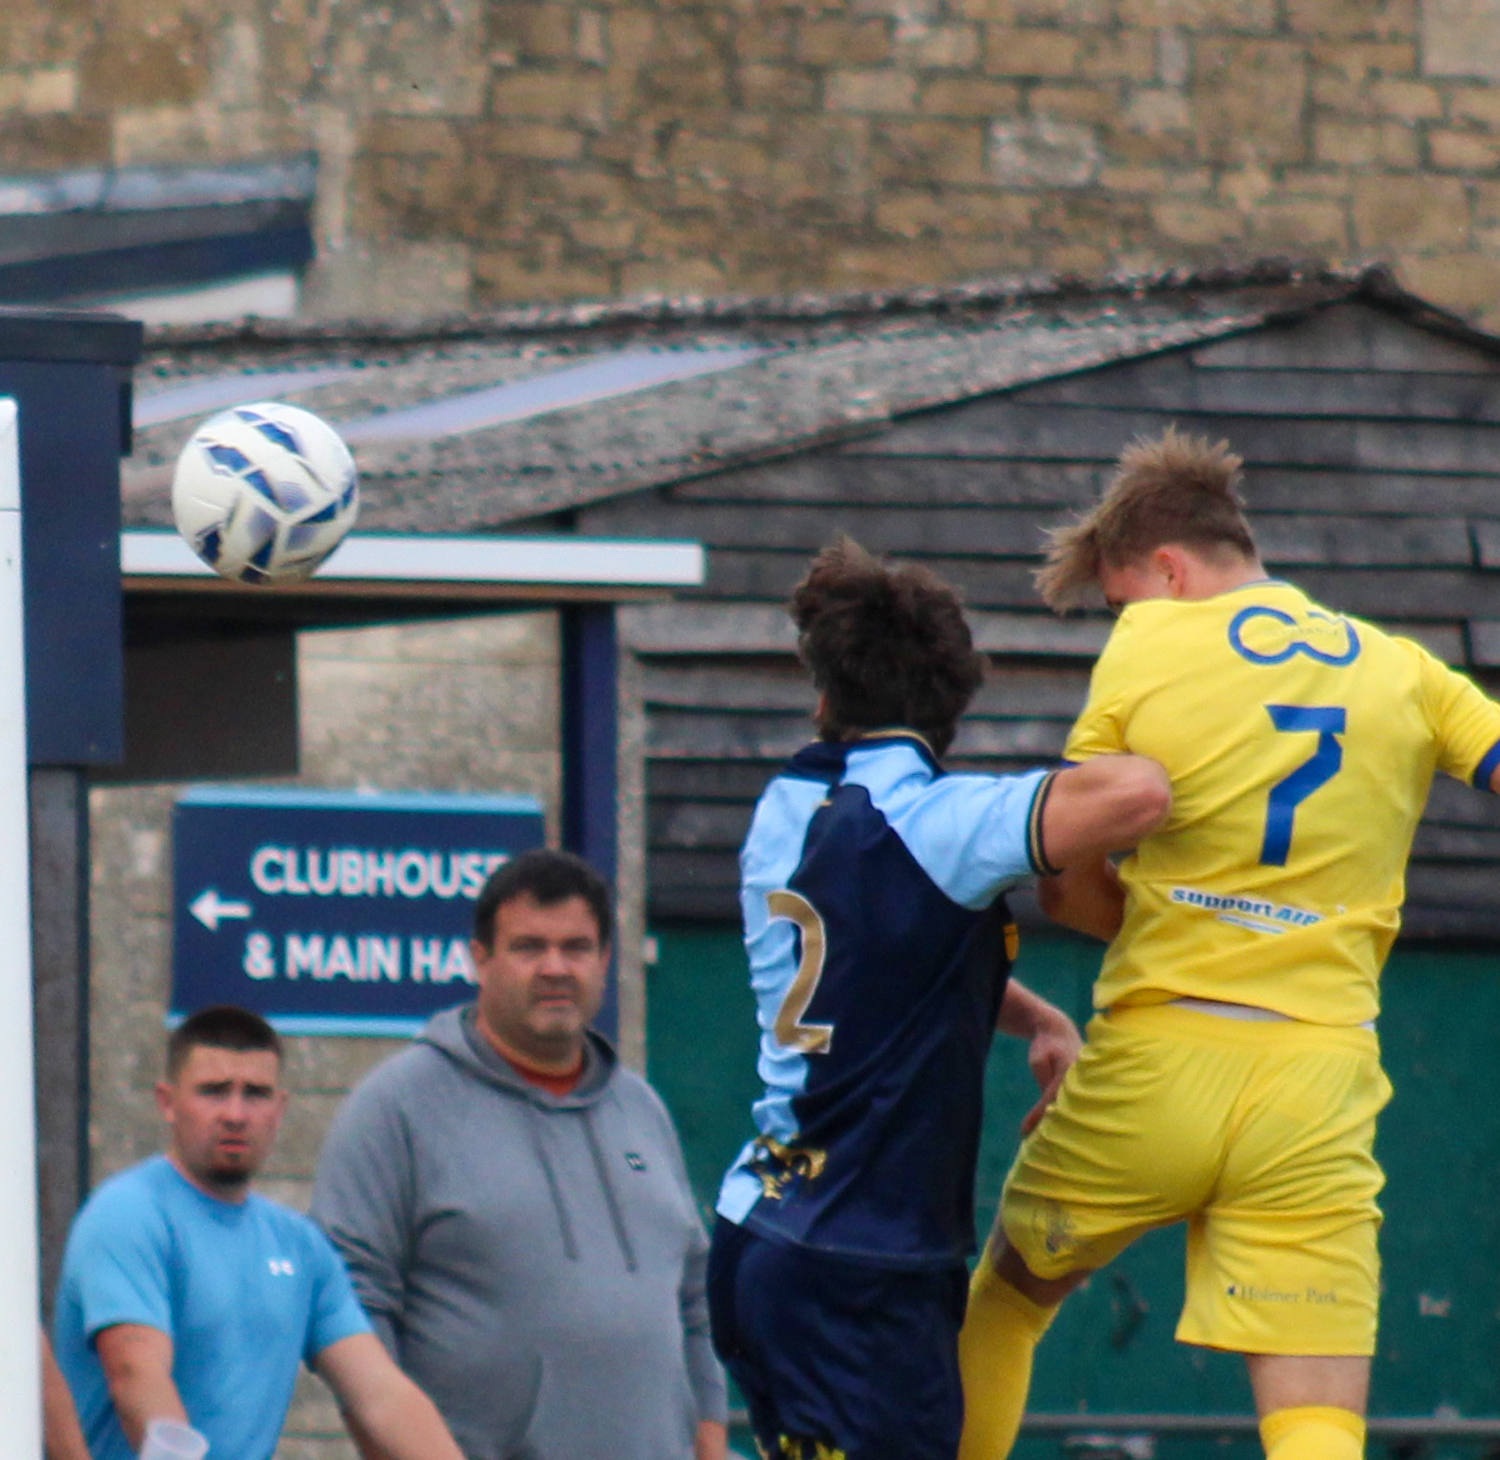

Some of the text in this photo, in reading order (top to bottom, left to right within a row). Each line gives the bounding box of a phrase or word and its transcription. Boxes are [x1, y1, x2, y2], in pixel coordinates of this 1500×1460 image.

[1259, 704, 1347, 867] 7
[245, 933, 275, 980] &
[286, 934, 402, 982] MAIN
[766, 888, 834, 1055] 2
